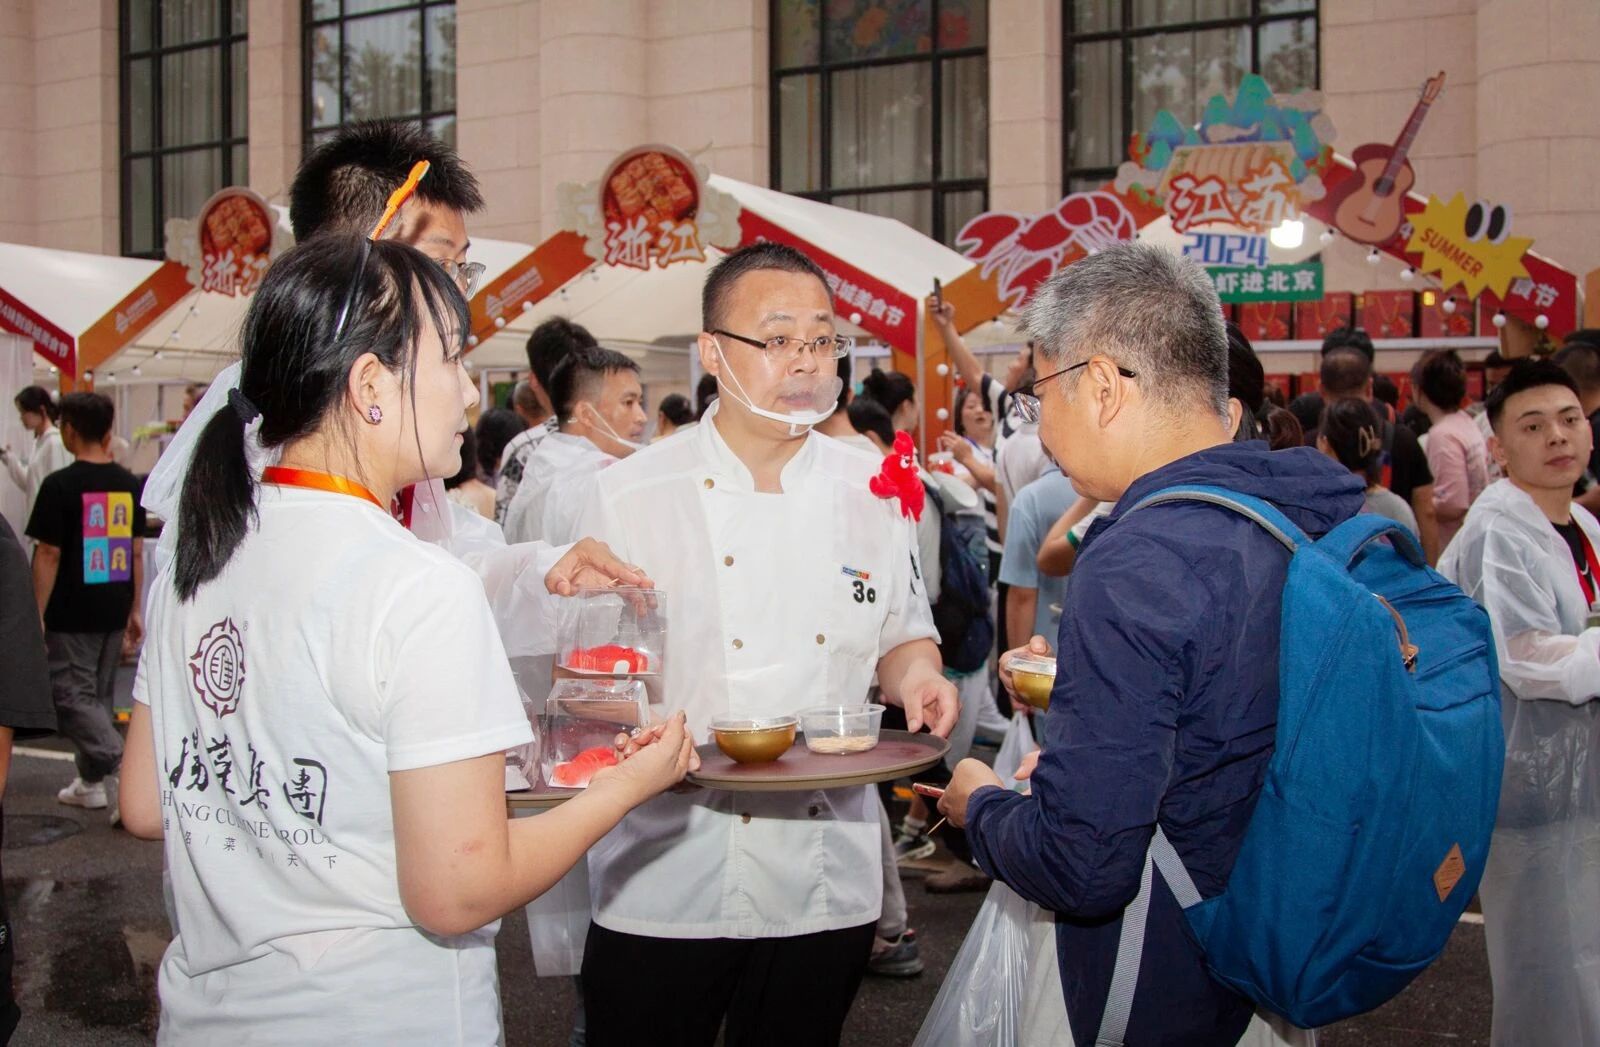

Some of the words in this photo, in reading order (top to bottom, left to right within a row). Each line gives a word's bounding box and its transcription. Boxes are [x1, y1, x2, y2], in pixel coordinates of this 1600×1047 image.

[1171, 160, 1297, 232] 江苏
[605, 215, 704, 269] 浙江
[1183, 232, 1268, 267] 2024
[1420, 228, 1484, 279] SUMMER
[1216, 270, 1316, 294] 虾进北京
[287, 853, 298, 867] 天
[323, 855, 337, 869] 下
